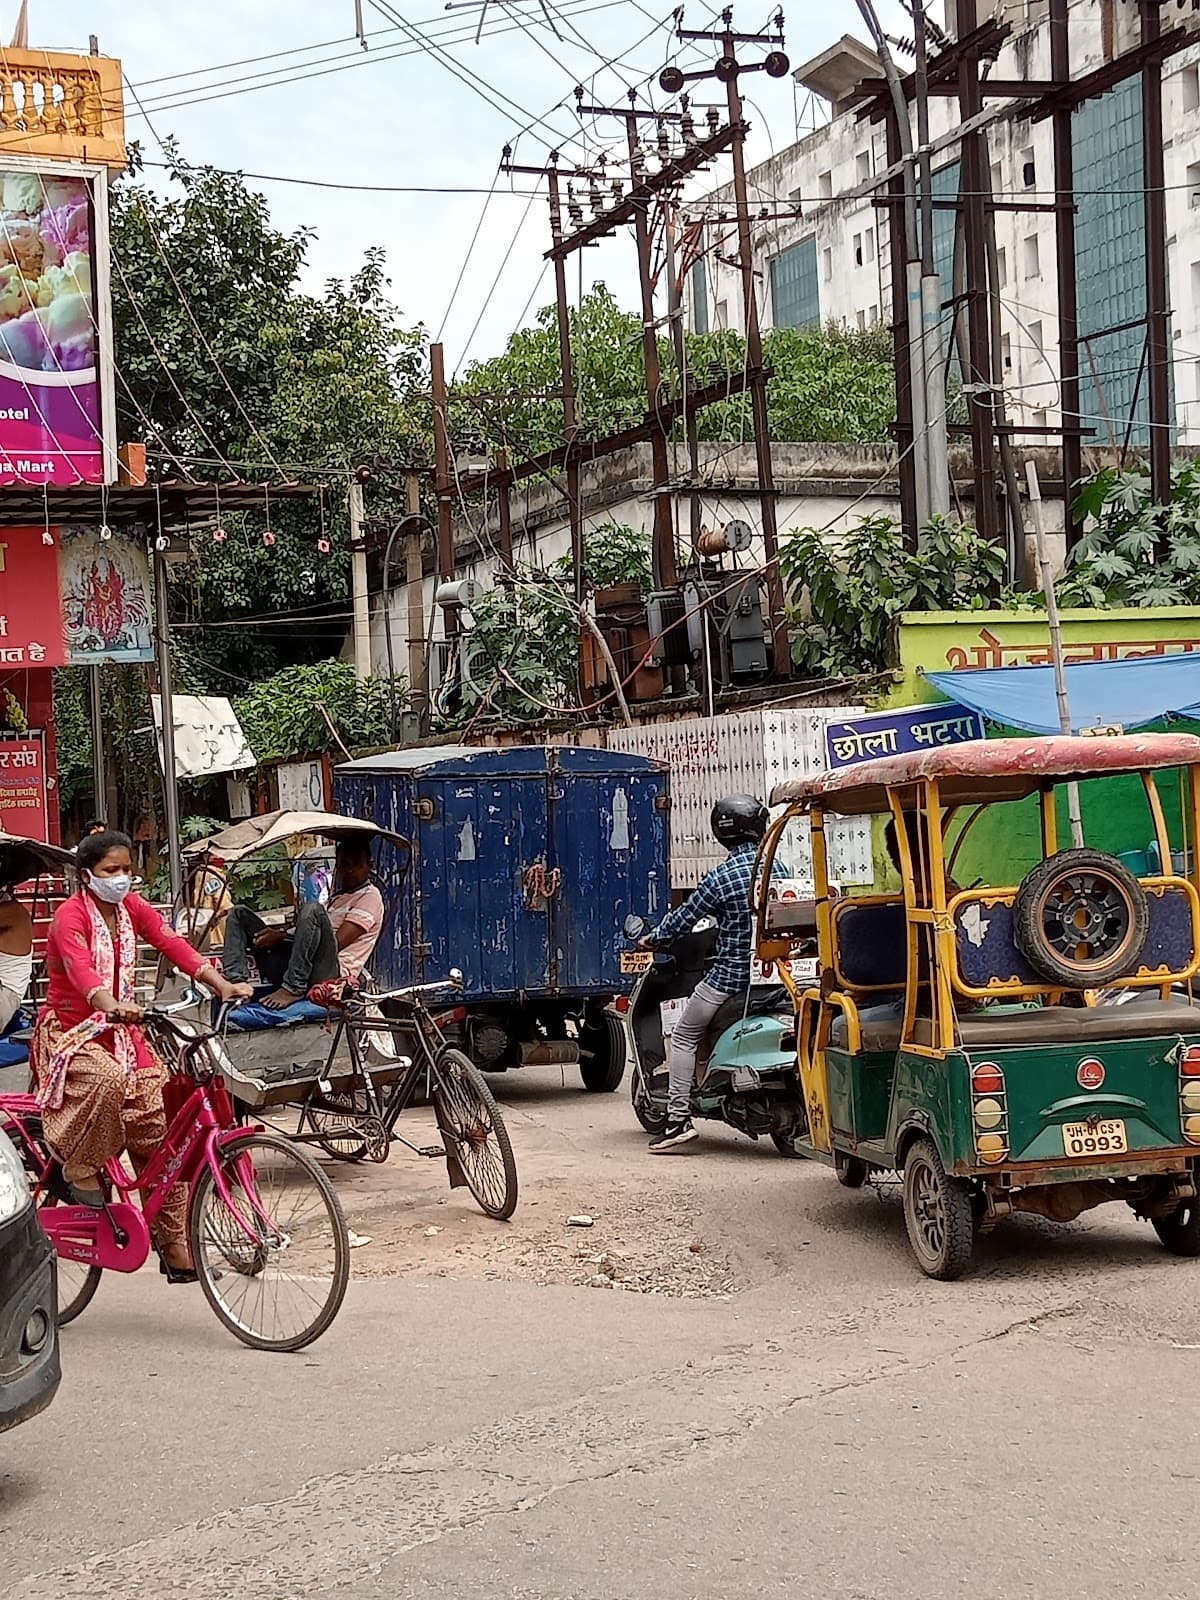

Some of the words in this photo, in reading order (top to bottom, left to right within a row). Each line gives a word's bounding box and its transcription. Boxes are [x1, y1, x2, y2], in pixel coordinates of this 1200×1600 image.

[17, 460, 55, 473] Mart
[28, 642, 46, 661] है
[831, 724, 899, 761] छोला
[11, 745, 37, 768] संघ
[1101, 1123, 1114, 1135] CS
[1071, 1135, 1123, 1153] 0993
